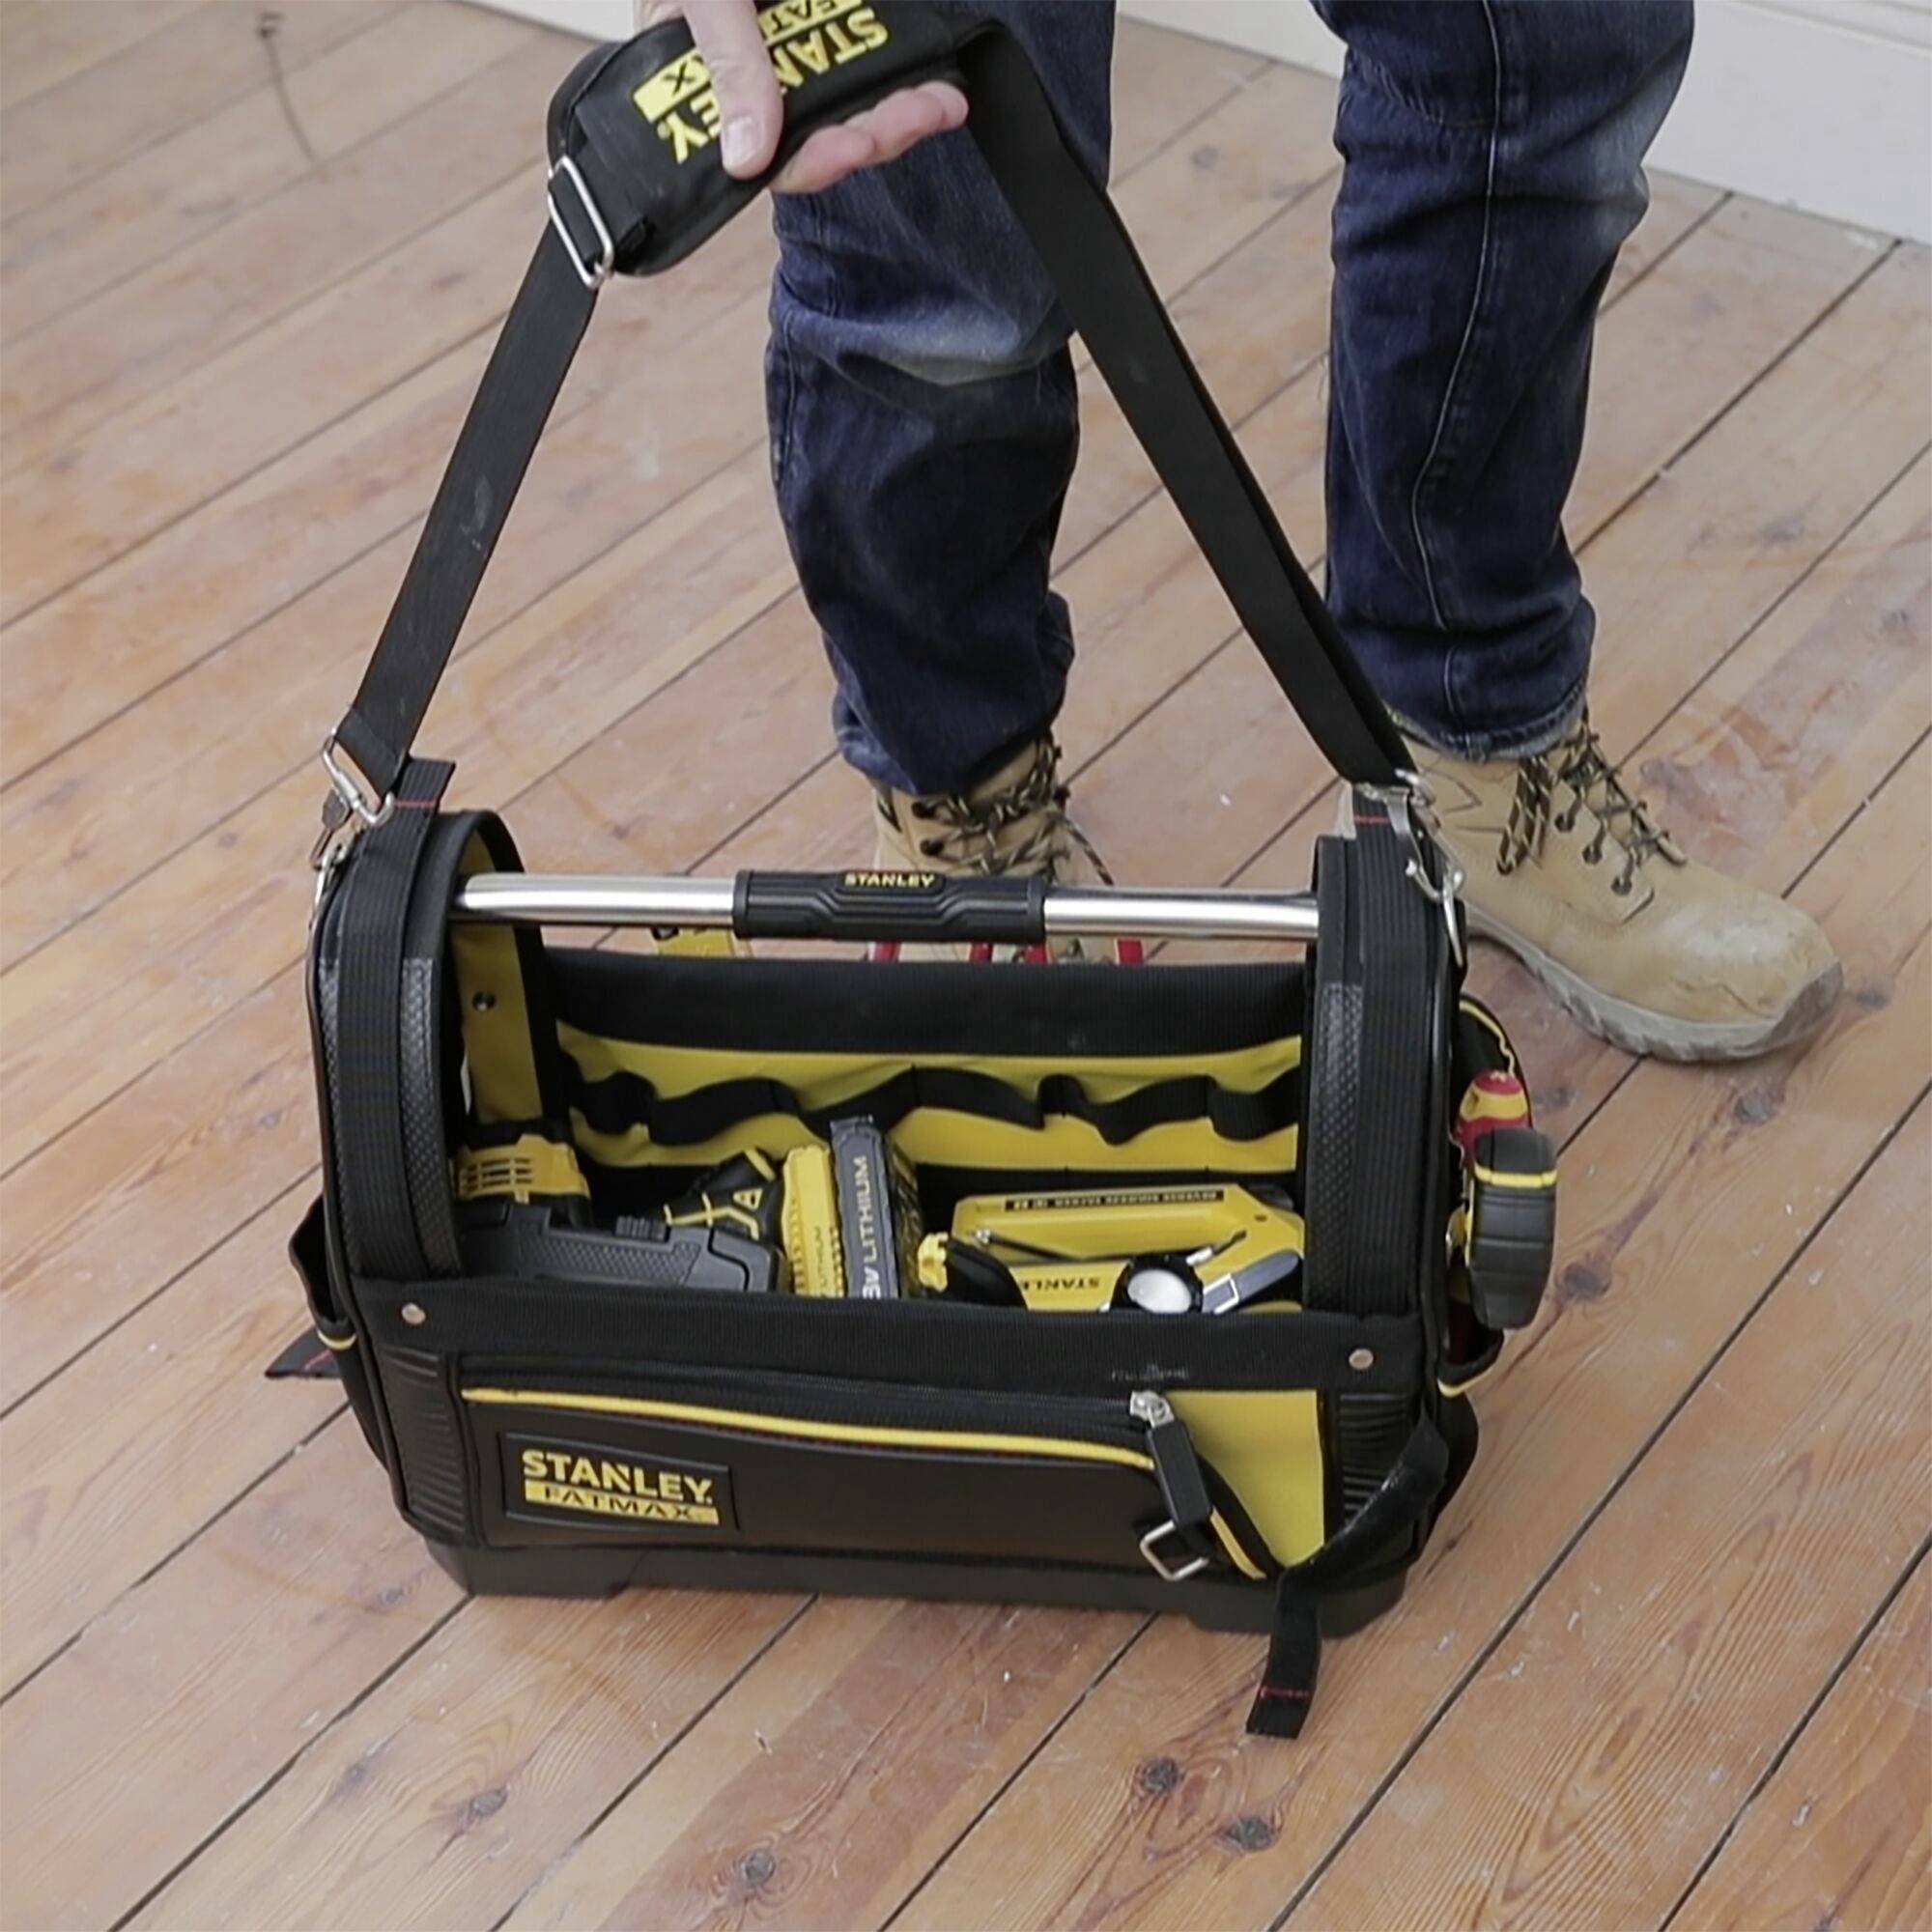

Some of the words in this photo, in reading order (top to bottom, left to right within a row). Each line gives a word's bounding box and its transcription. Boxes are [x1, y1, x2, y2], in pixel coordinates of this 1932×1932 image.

[665, 6, 888, 164] STANEY
[844, 871, 935, 888] STANLEY
[853, 1155, 877, 1264] LITHIUM
[1022, 1277, 1100, 1292] STANLE
[522, 1449, 713, 1504] STANLEY
[543, 1483, 694, 1520] FATMAX
